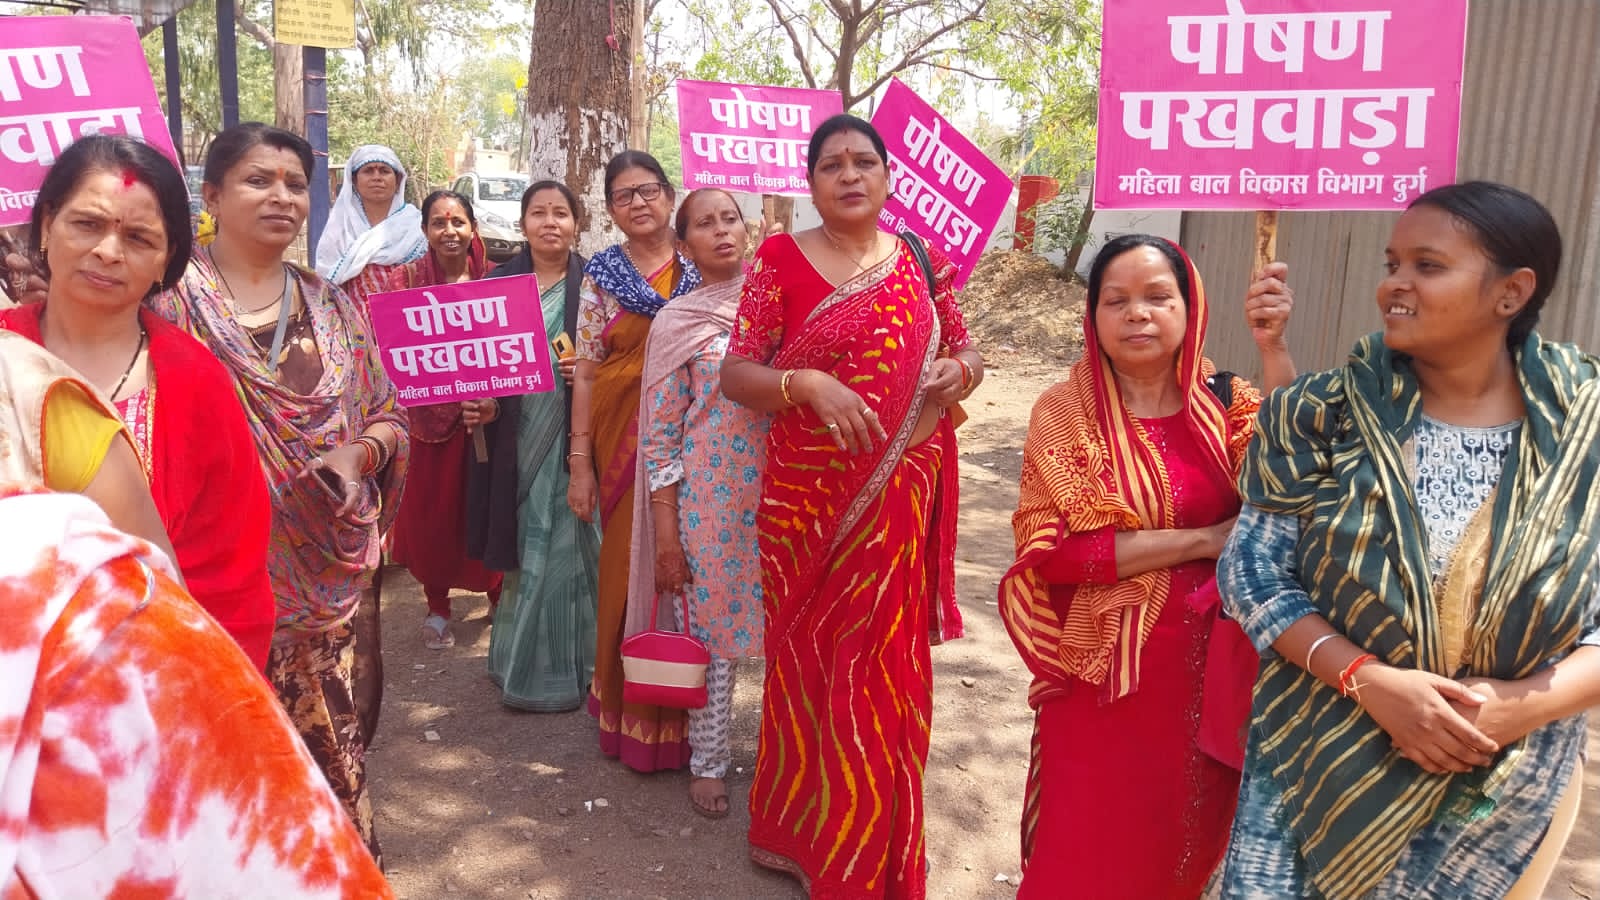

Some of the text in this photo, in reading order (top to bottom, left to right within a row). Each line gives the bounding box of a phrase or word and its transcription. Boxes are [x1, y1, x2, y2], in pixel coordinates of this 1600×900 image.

[1167, 0, 1392, 74] पोषण
[708, 87, 811, 133] पोषण
[1120, 88, 1435, 165] पखवाड़ा
[694, 171, 725, 185] महिला
[730, 175, 749, 186] बाल
[753, 173, 786, 188] विकास
[903, 115, 987, 207] पोषण
[886, 151, 982, 256] खवाड़ा
[1119, 167, 1427, 202] महिला बाल विकास विभाग दुर्ग
[402, 291, 509, 336] पोषण
[389, 332, 536, 376] पखवाड़ा
[398, 371, 541, 400] महिला बाल विकास विभाग दुर्ग
